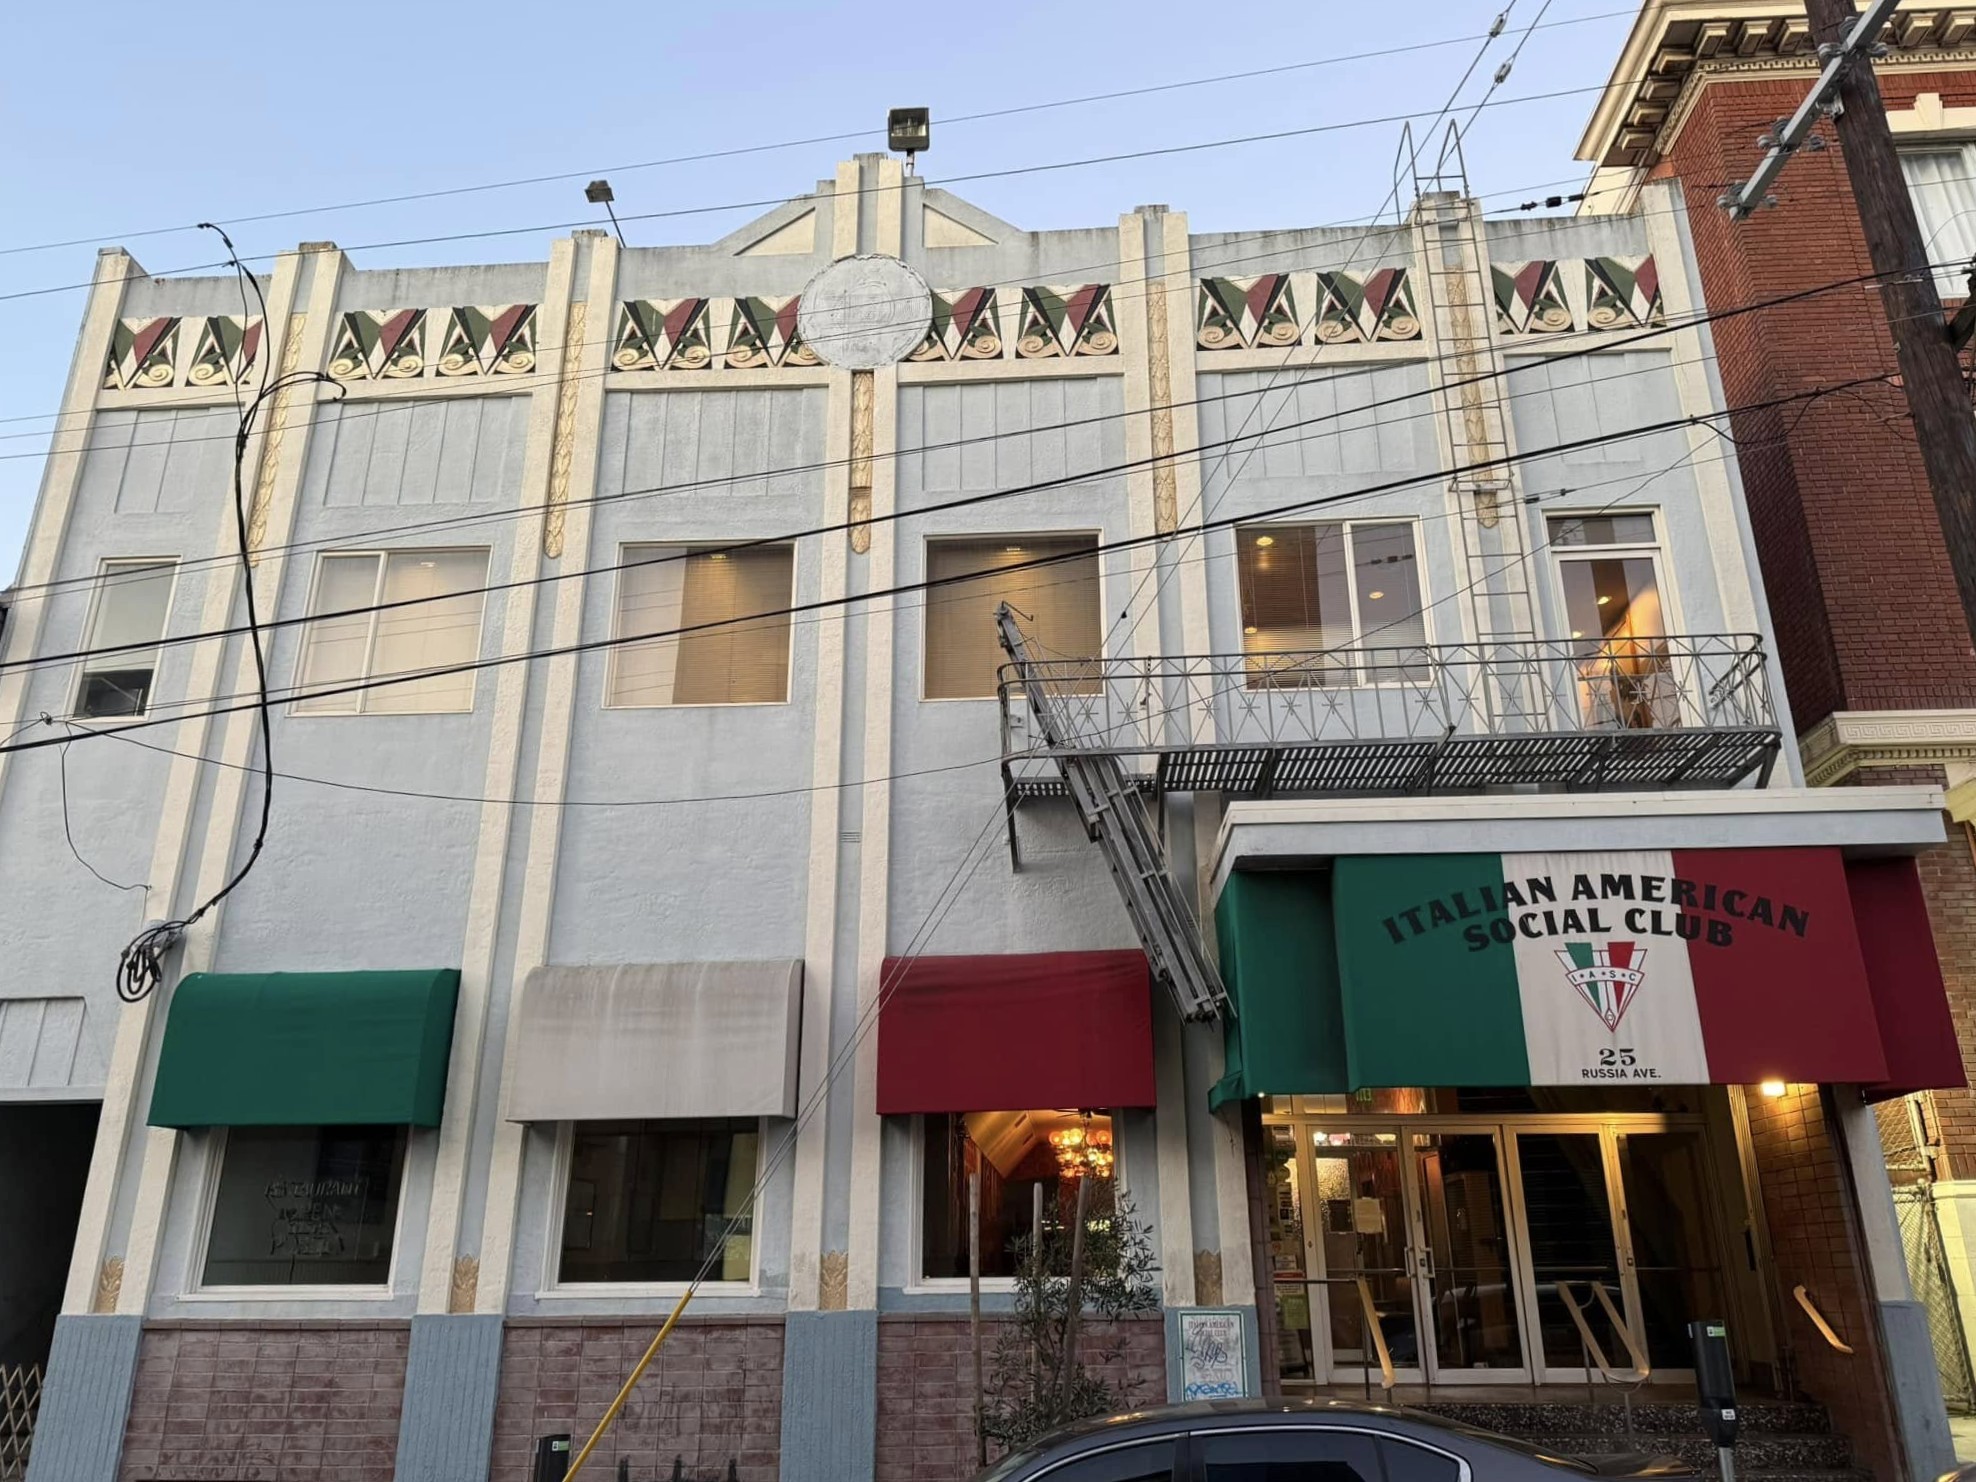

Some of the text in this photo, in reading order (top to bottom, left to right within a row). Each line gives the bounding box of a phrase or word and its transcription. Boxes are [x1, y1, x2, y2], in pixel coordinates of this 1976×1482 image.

[1382, 873, 1810, 945] ITALIAN AMERICAN
[1462, 907, 1734, 953] SOCIAL CLUB
[1581, 1068, 1662, 1078] RUSSIA AVE.
[1599, 1048, 1636, 1066] 25
